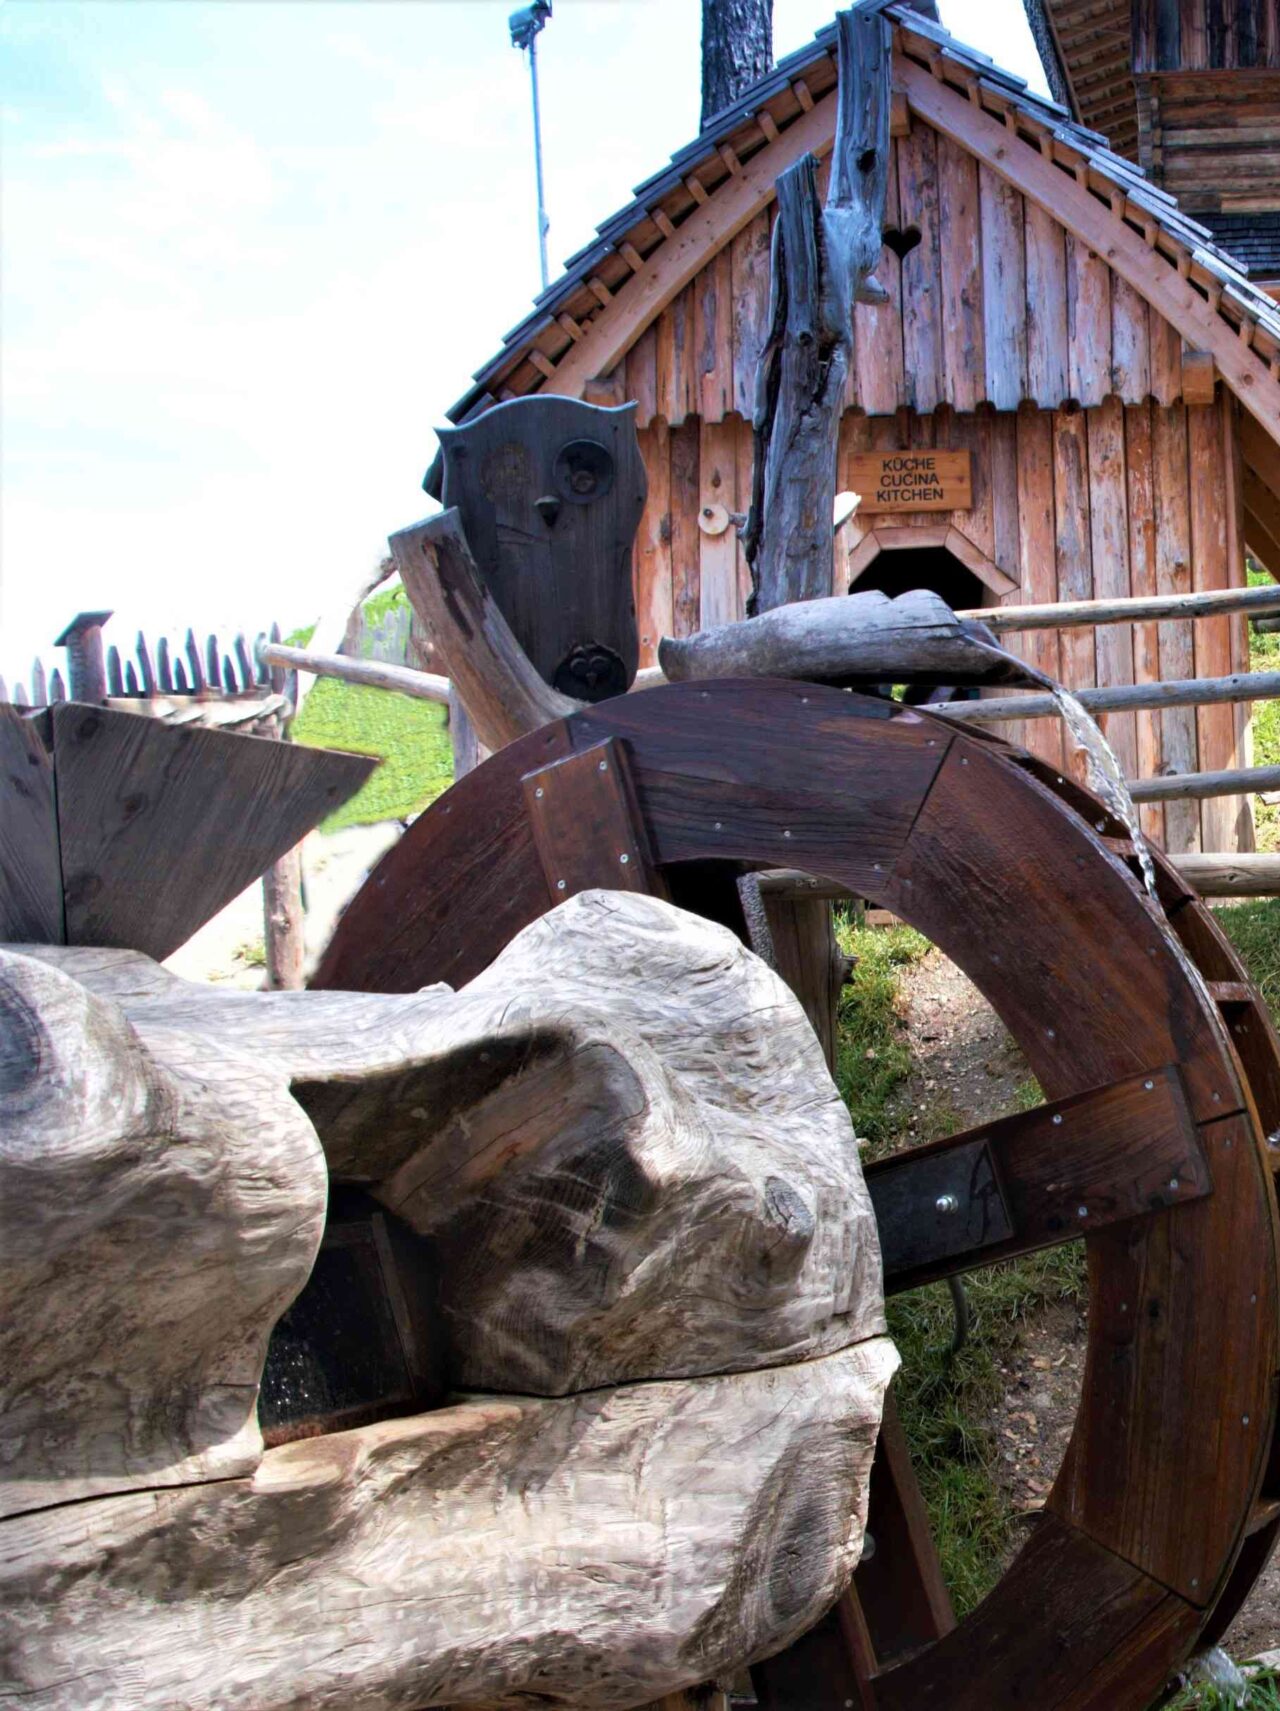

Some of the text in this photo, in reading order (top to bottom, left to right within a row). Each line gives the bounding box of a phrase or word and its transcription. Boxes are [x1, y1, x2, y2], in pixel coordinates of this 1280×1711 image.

[882, 456, 936, 472] KÜCHE
[880, 472, 940, 488] CUCINA
[876, 488, 944, 502] KITCHEN
